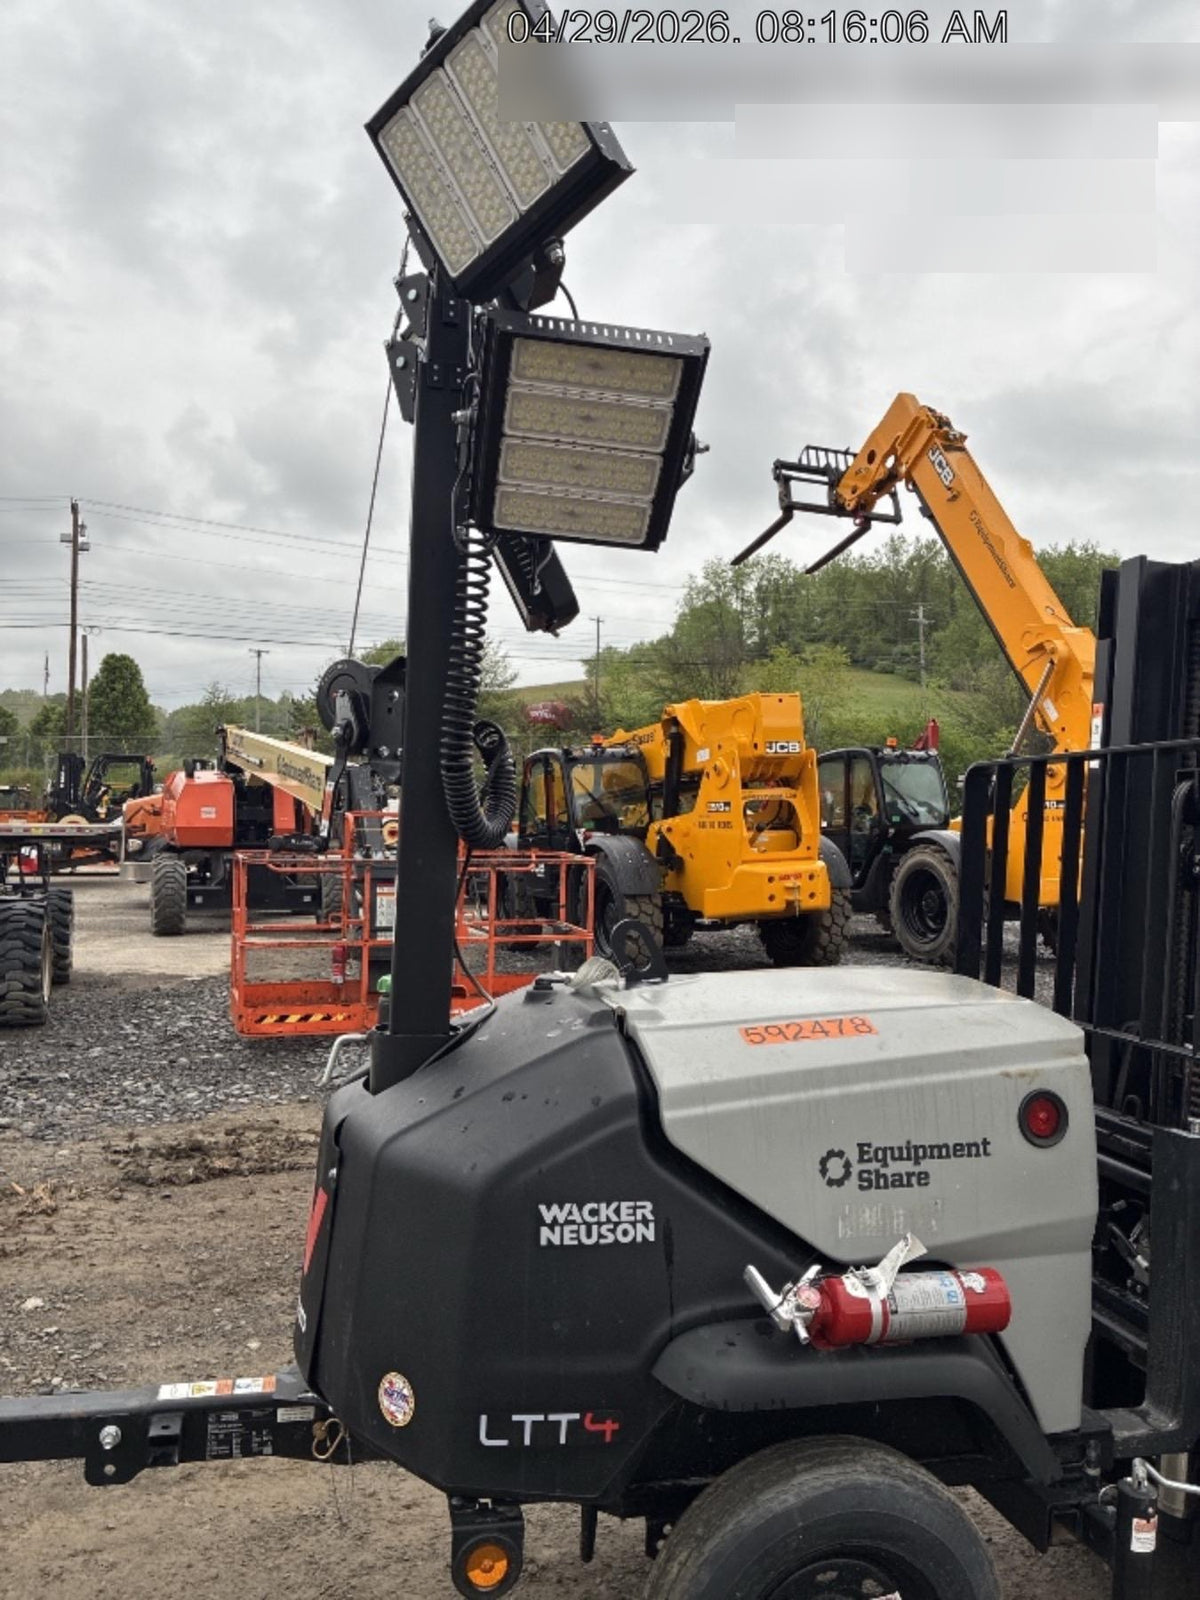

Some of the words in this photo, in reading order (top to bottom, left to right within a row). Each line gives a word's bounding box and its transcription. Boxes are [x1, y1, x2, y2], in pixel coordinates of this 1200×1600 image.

[927, 447, 955, 489] JCB
[765, 741, 800, 753] JCB
[744, 1016, 873, 1045] 592478
[856, 1137, 991, 1166] Equipment
[857, 1168, 931, 1191] Share
[537, 1201, 655, 1224] WACKER
[539, 1222, 656, 1246] NEUSON
[479, 1412, 619, 1446] LTT4
